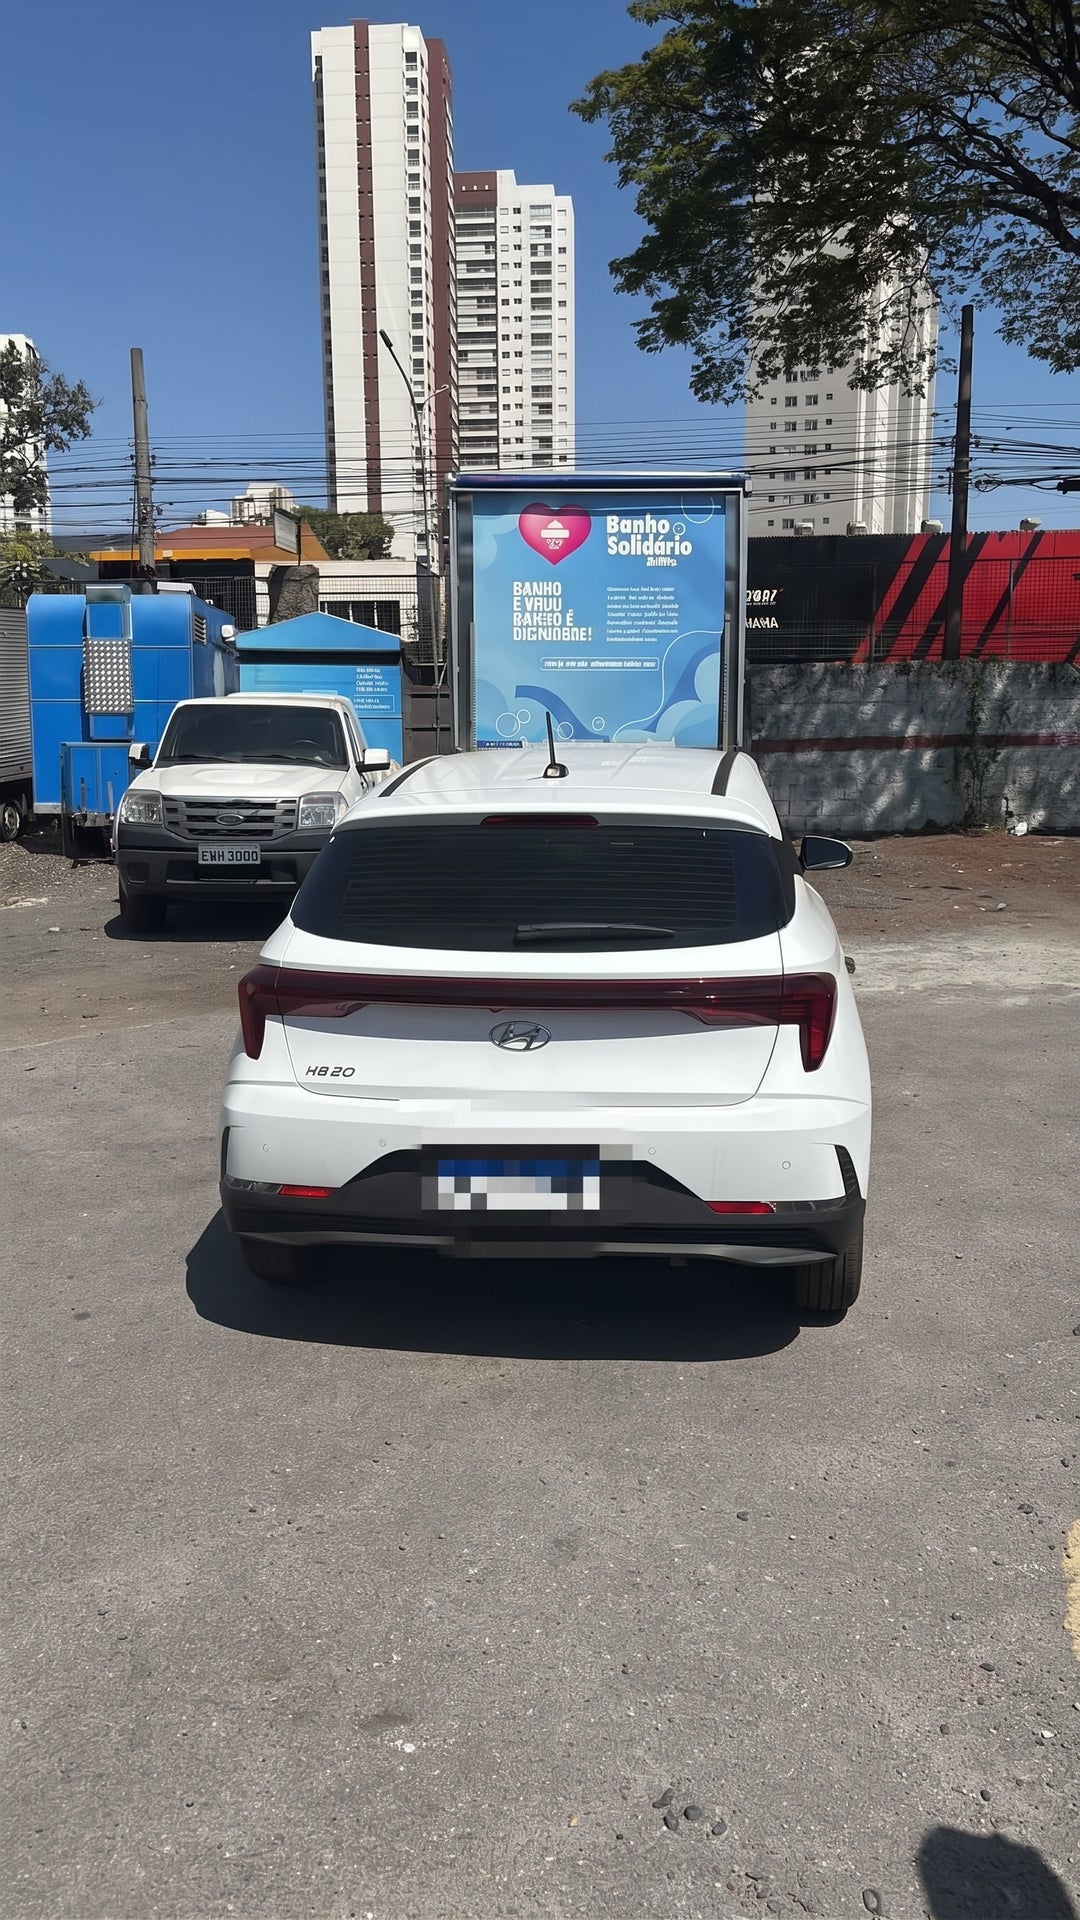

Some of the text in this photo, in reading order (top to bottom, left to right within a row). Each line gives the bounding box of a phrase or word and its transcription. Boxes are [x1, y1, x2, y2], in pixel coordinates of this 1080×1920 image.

[606, 512, 670, 534] Banho
[607, 533, 693, 556] Solidário
[513, 581, 562, 596] BANHO
[566, 608, 574, 626] É
[227, 850, 259, 862] 3000
[305, 1065, 356, 1078] HB20
